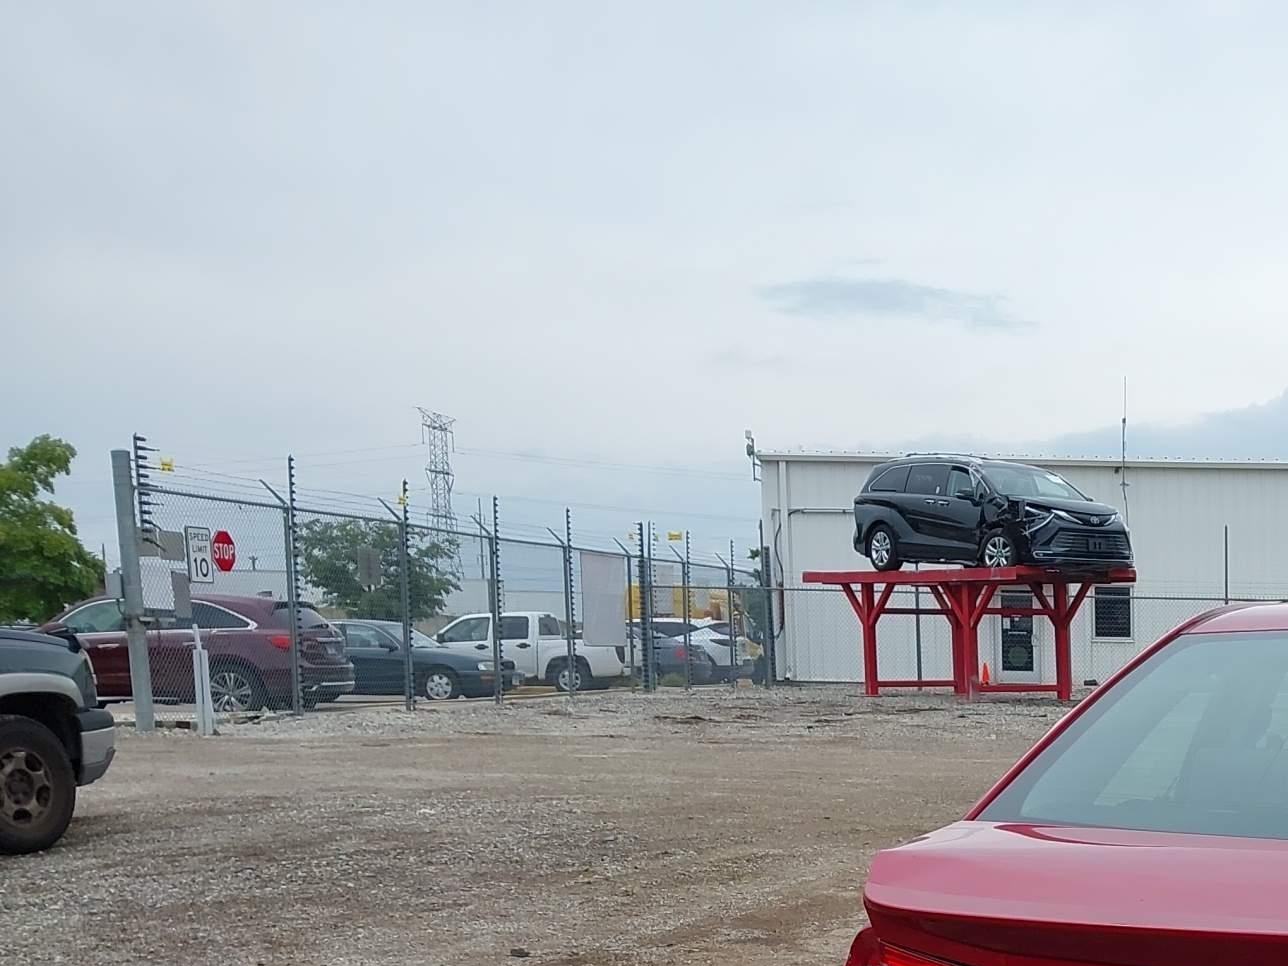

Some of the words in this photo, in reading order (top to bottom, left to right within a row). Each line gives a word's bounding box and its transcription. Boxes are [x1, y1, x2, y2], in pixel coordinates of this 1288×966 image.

[189, 532, 208, 541] SPEED
[192, 545, 207, 553] LIMIT
[214, 544, 234, 560] STOP
[194, 557, 209, 577] 10
